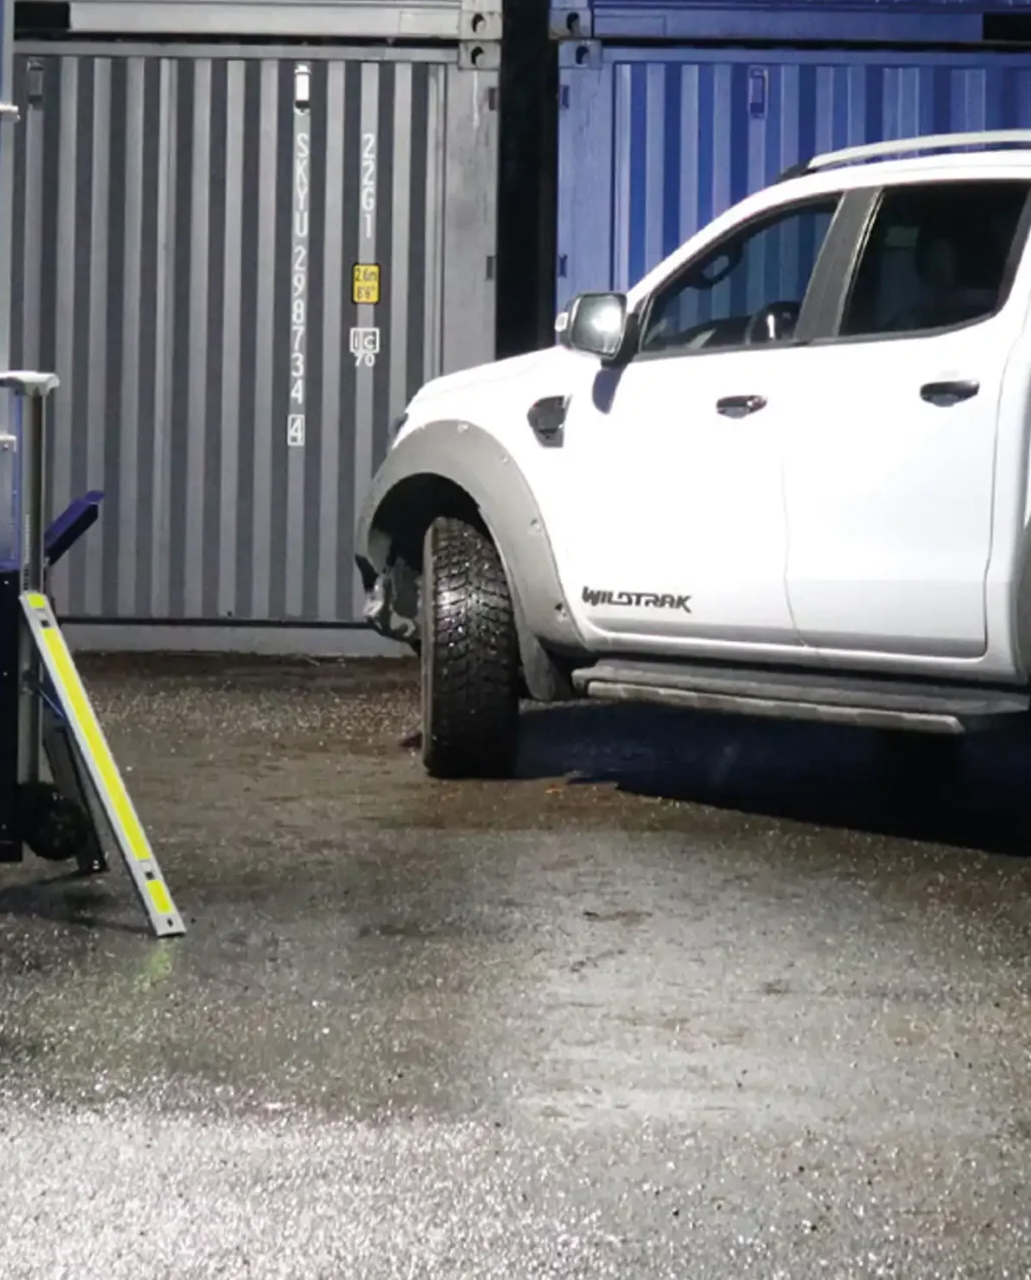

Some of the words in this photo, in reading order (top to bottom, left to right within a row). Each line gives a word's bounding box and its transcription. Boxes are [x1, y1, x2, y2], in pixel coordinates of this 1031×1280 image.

[293, 133, 310, 238] SKYU
[360, 133, 376, 238] 22G1
[290, 246, 307, 405] 298734
[355, 352, 375, 368] 70
[288, 416, 304, 444] 4
[582, 586, 692, 614] WILDTRAK
